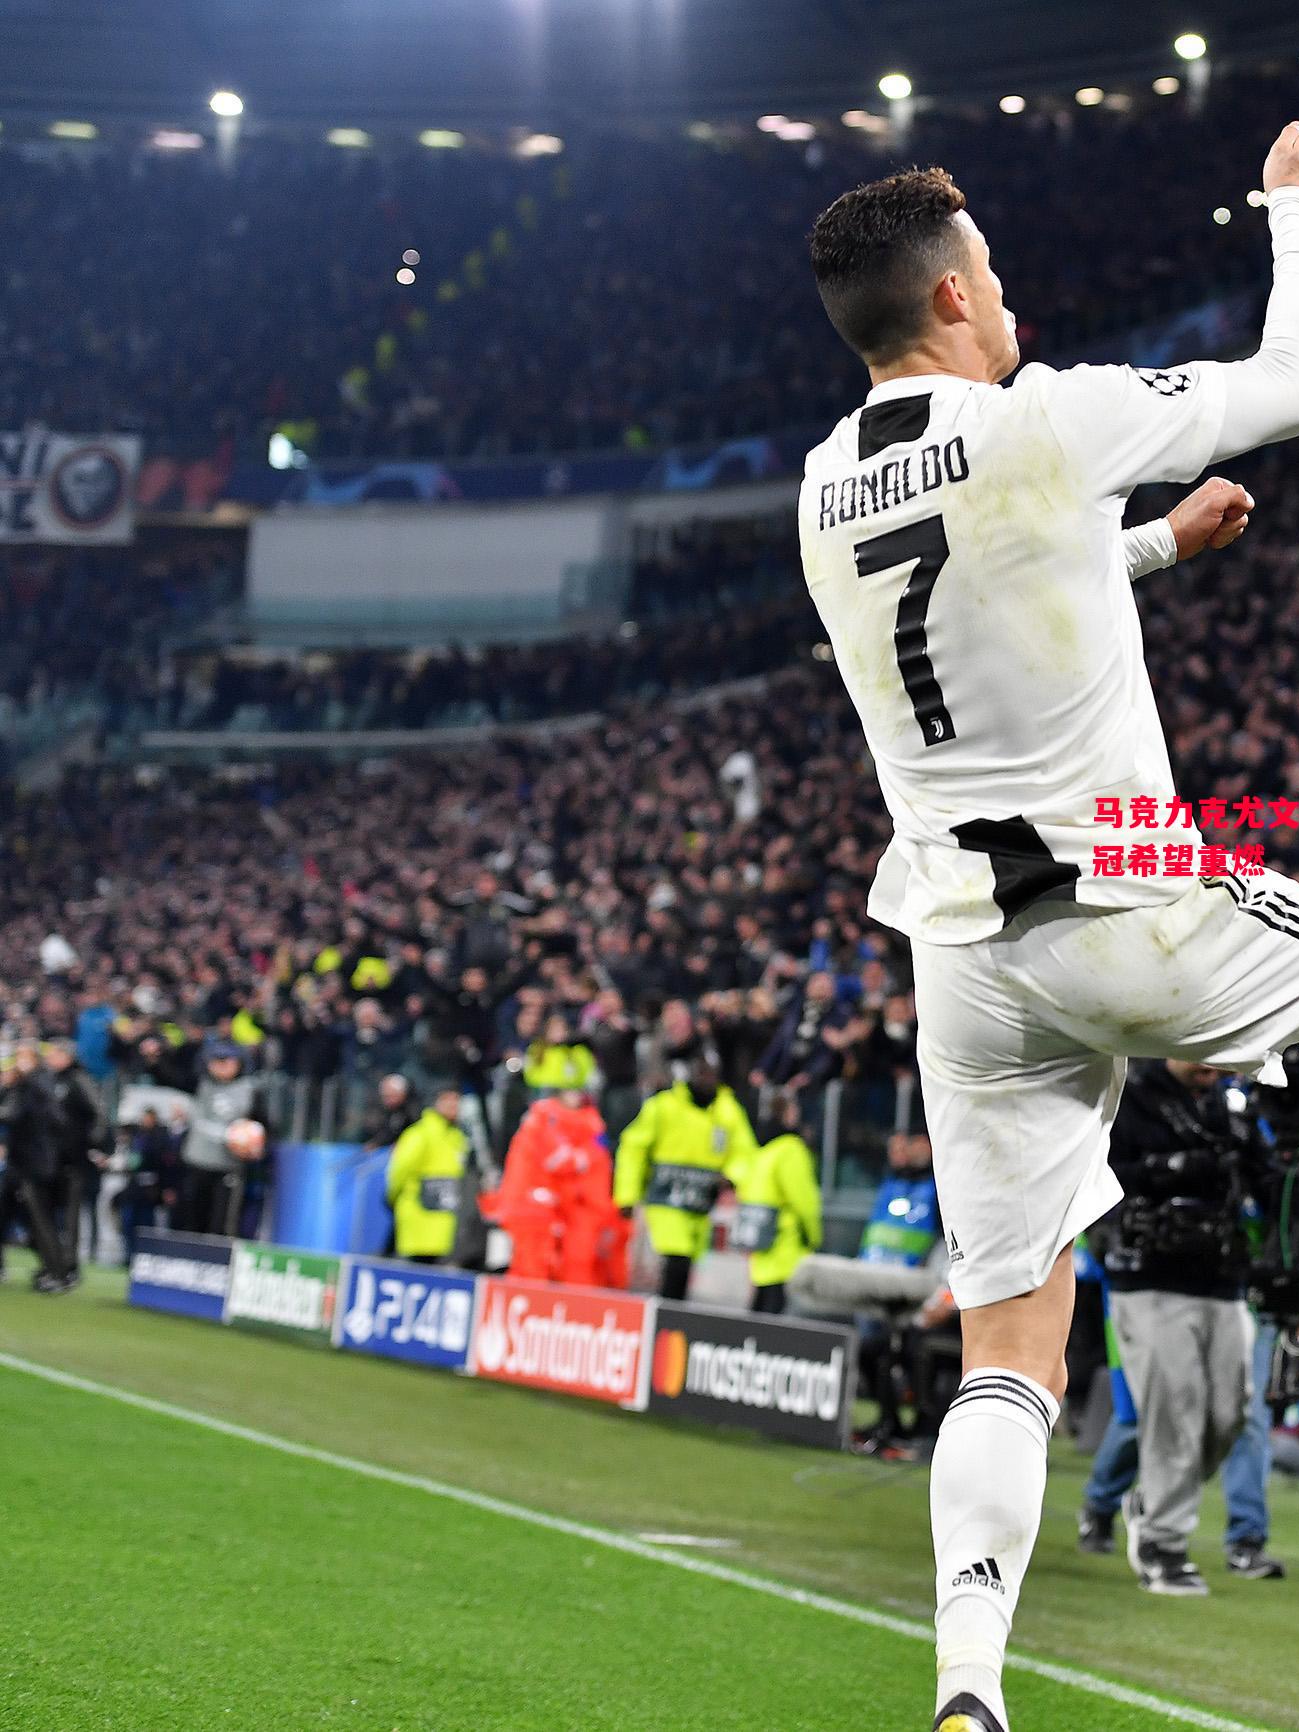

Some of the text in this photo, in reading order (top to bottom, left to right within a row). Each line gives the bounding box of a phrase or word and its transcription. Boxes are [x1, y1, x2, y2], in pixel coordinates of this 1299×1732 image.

[820, 435, 969, 531] RONALDO
[853, 512, 957, 747] 7
[505, 1294, 641, 1394] Santander
[686, 1336, 844, 1421] mastercard
[951, 1572, 1006, 1595] adidas
